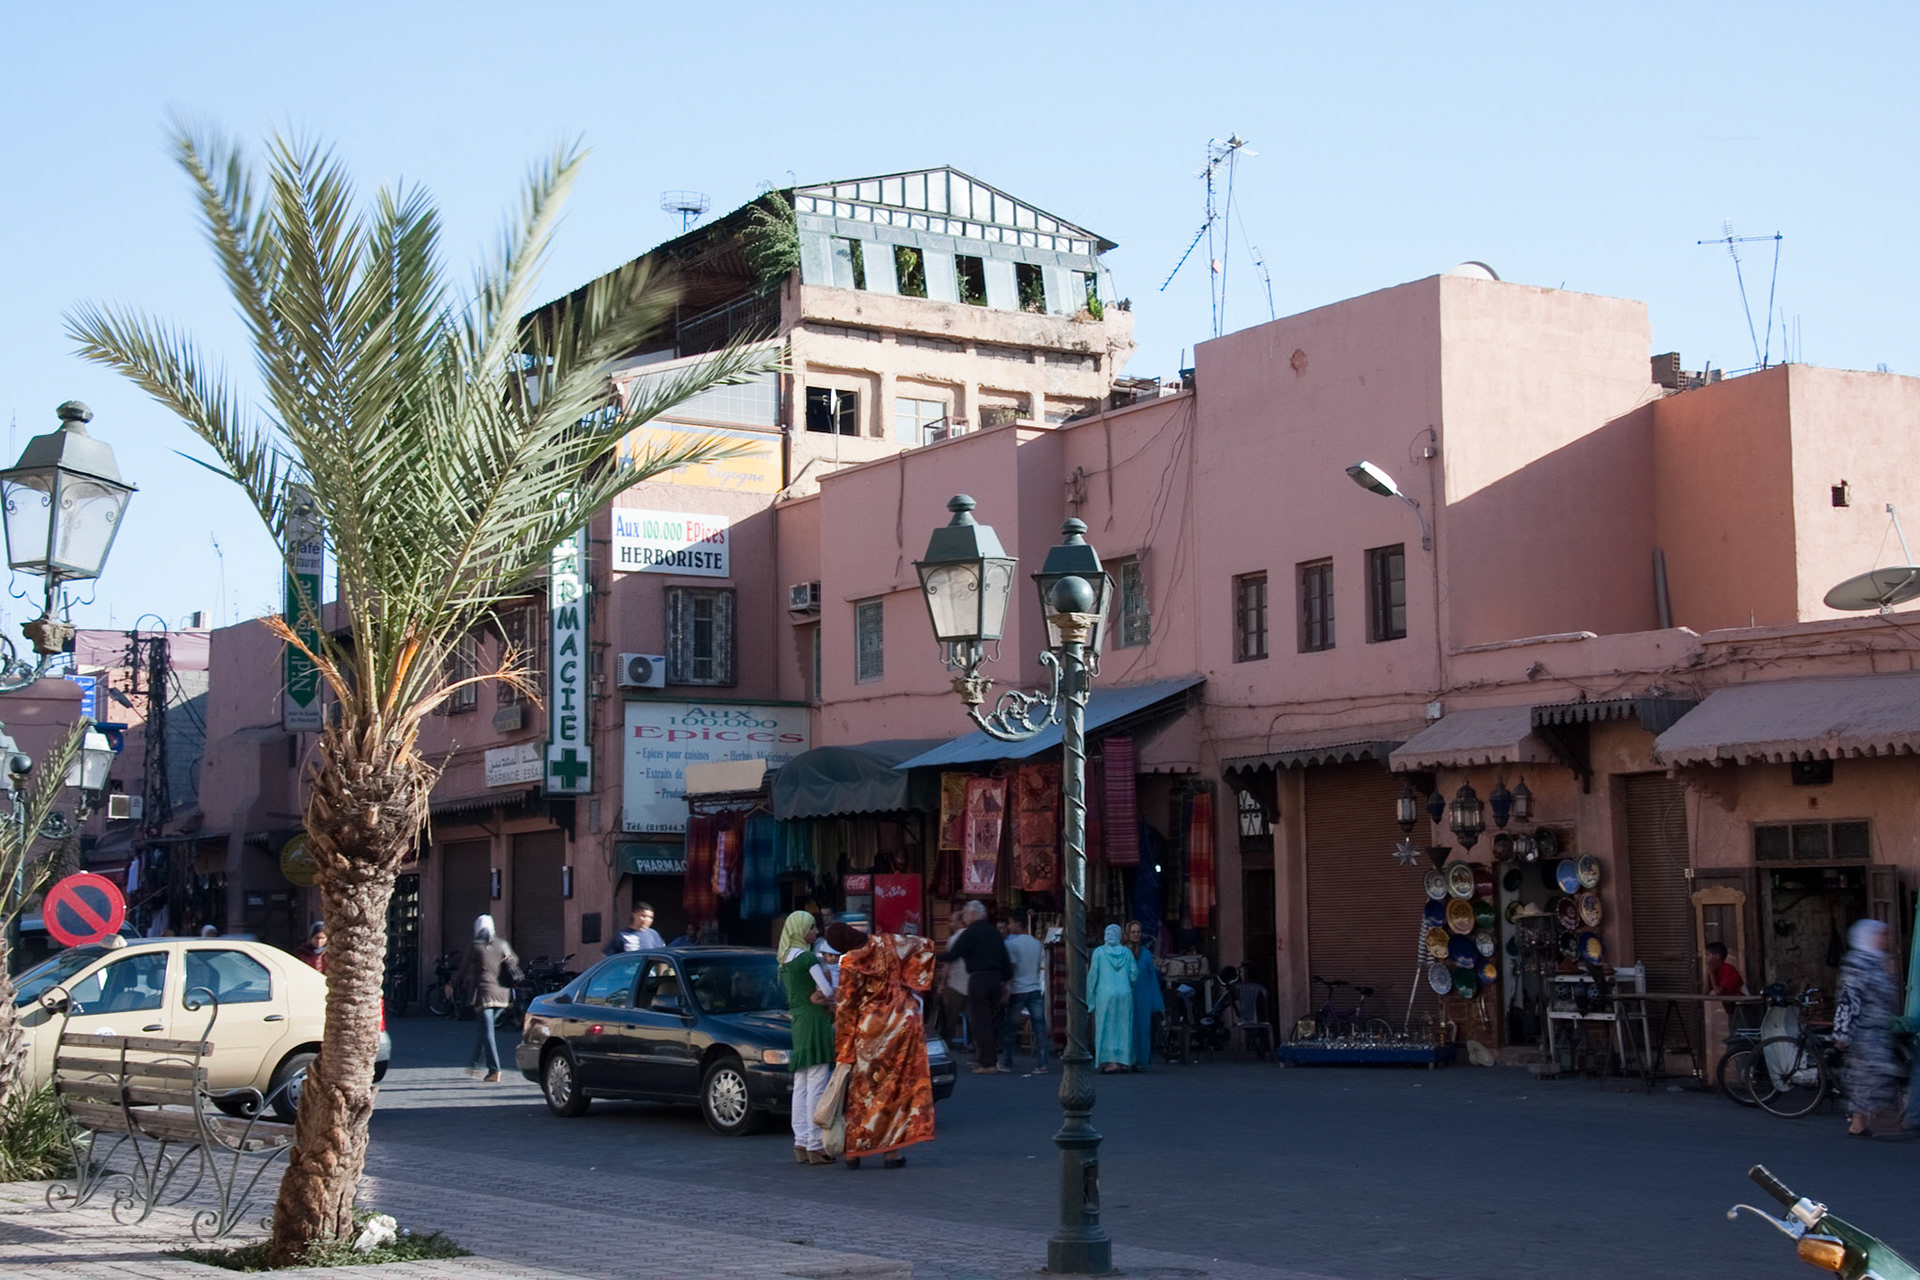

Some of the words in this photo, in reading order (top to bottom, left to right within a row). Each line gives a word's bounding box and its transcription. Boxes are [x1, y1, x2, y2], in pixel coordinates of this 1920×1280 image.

[616, 514, 640, 538] Aux
[643, 520, 683, 541] 100.000
[621, 546, 722, 570] HERBORISTE
[557, 498, 580, 740] HARMACIE
[686, 707, 753, 719] Aux
[669, 716, 778, 729] 100.000
[633, 725, 804, 743] Epices
[642, 748, 663, 760] Epices
[665, 750, 682, 762] pour
[646, 768, 674, 780] Extraits
[675, 768, 683, 780] de
